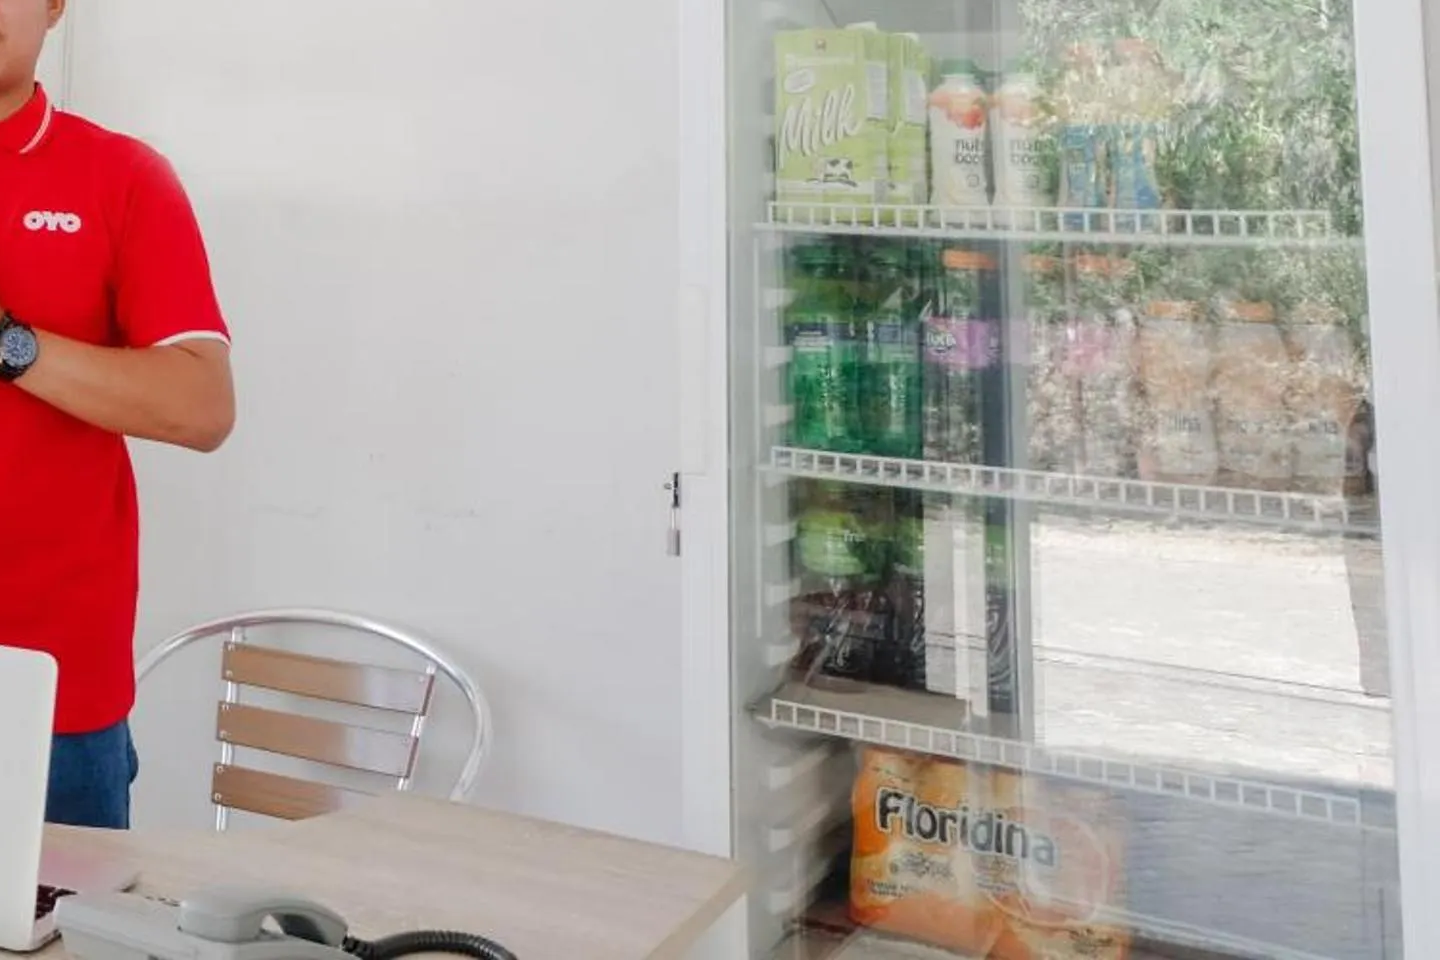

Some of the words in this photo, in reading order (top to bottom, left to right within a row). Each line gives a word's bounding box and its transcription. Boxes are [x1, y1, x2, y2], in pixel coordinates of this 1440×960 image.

[777, 83, 862, 172] Milk
[23, 210, 82, 233] OYO
[877, 788, 1056, 867] Floridina
